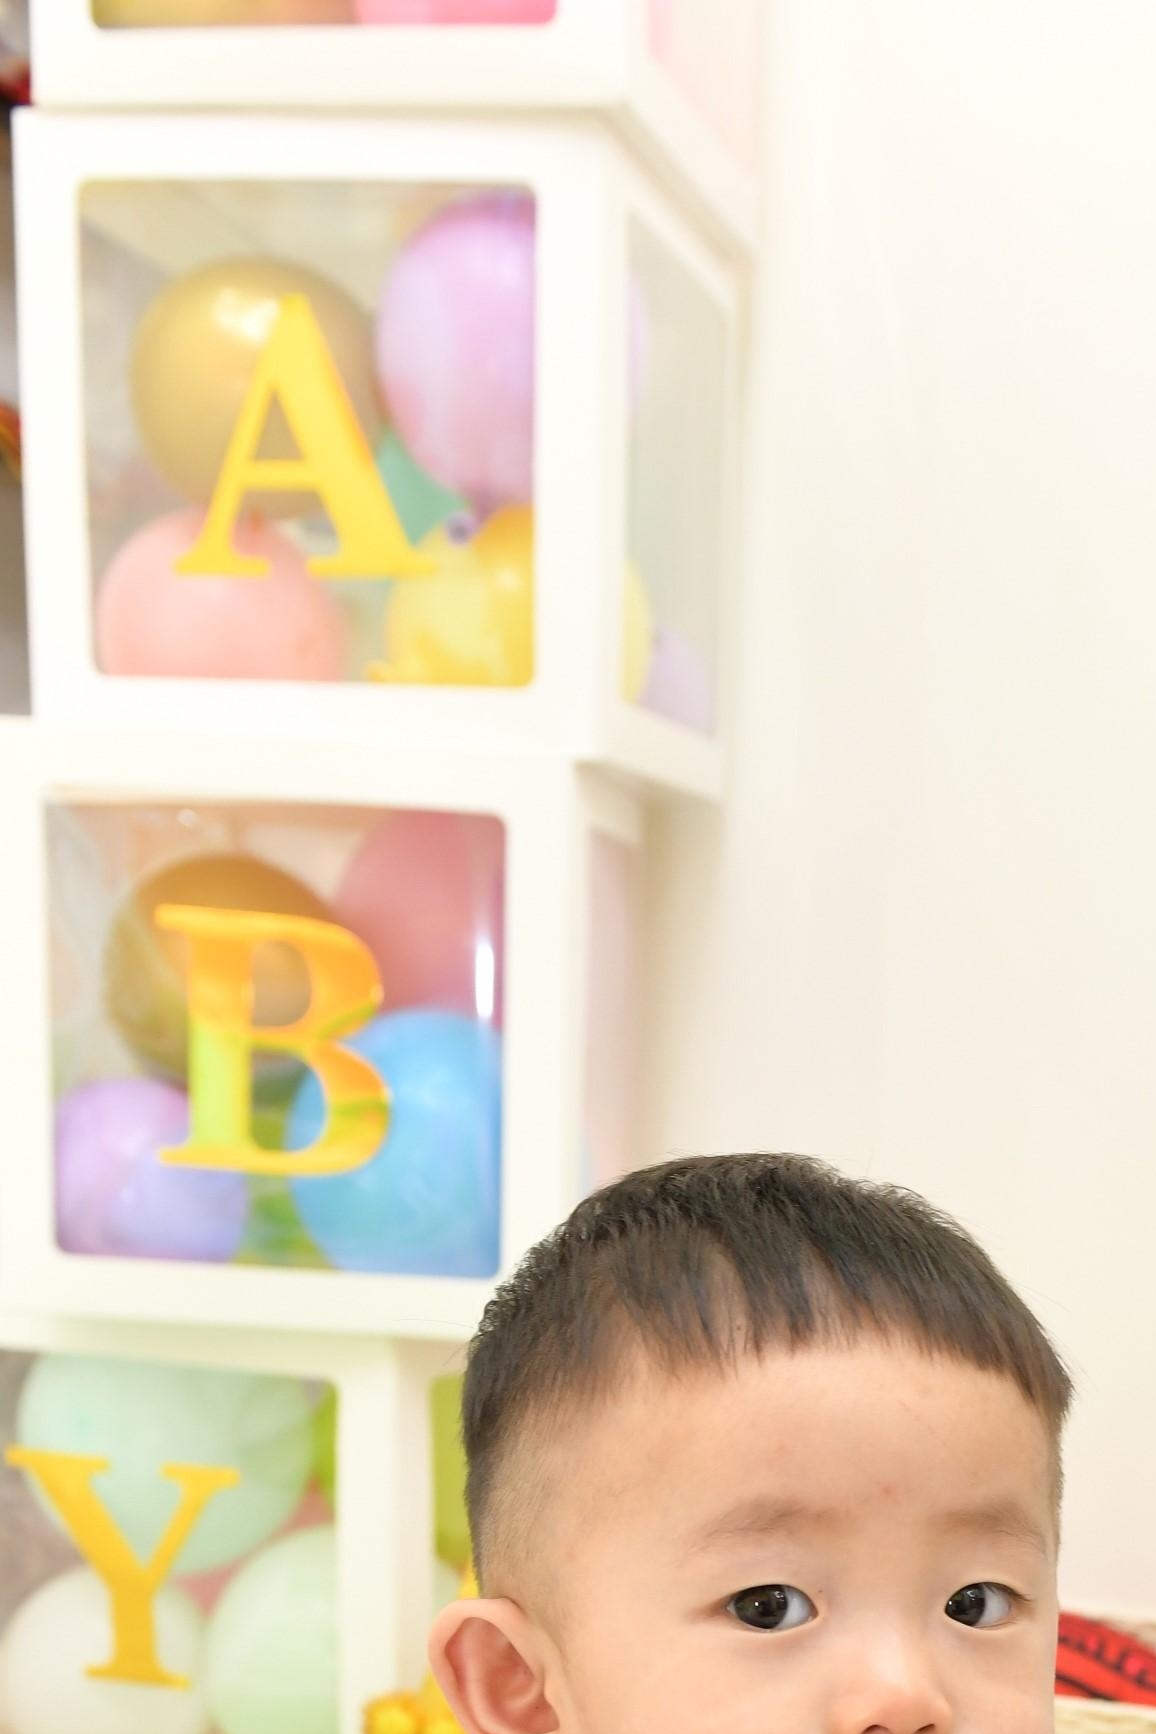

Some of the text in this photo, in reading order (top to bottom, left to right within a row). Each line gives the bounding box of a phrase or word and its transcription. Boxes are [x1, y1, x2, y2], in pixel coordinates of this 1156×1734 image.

[172, 292, 440, 580] A
[153, 903, 393, 1176] B
[4, 1446, 240, 1690] Y
